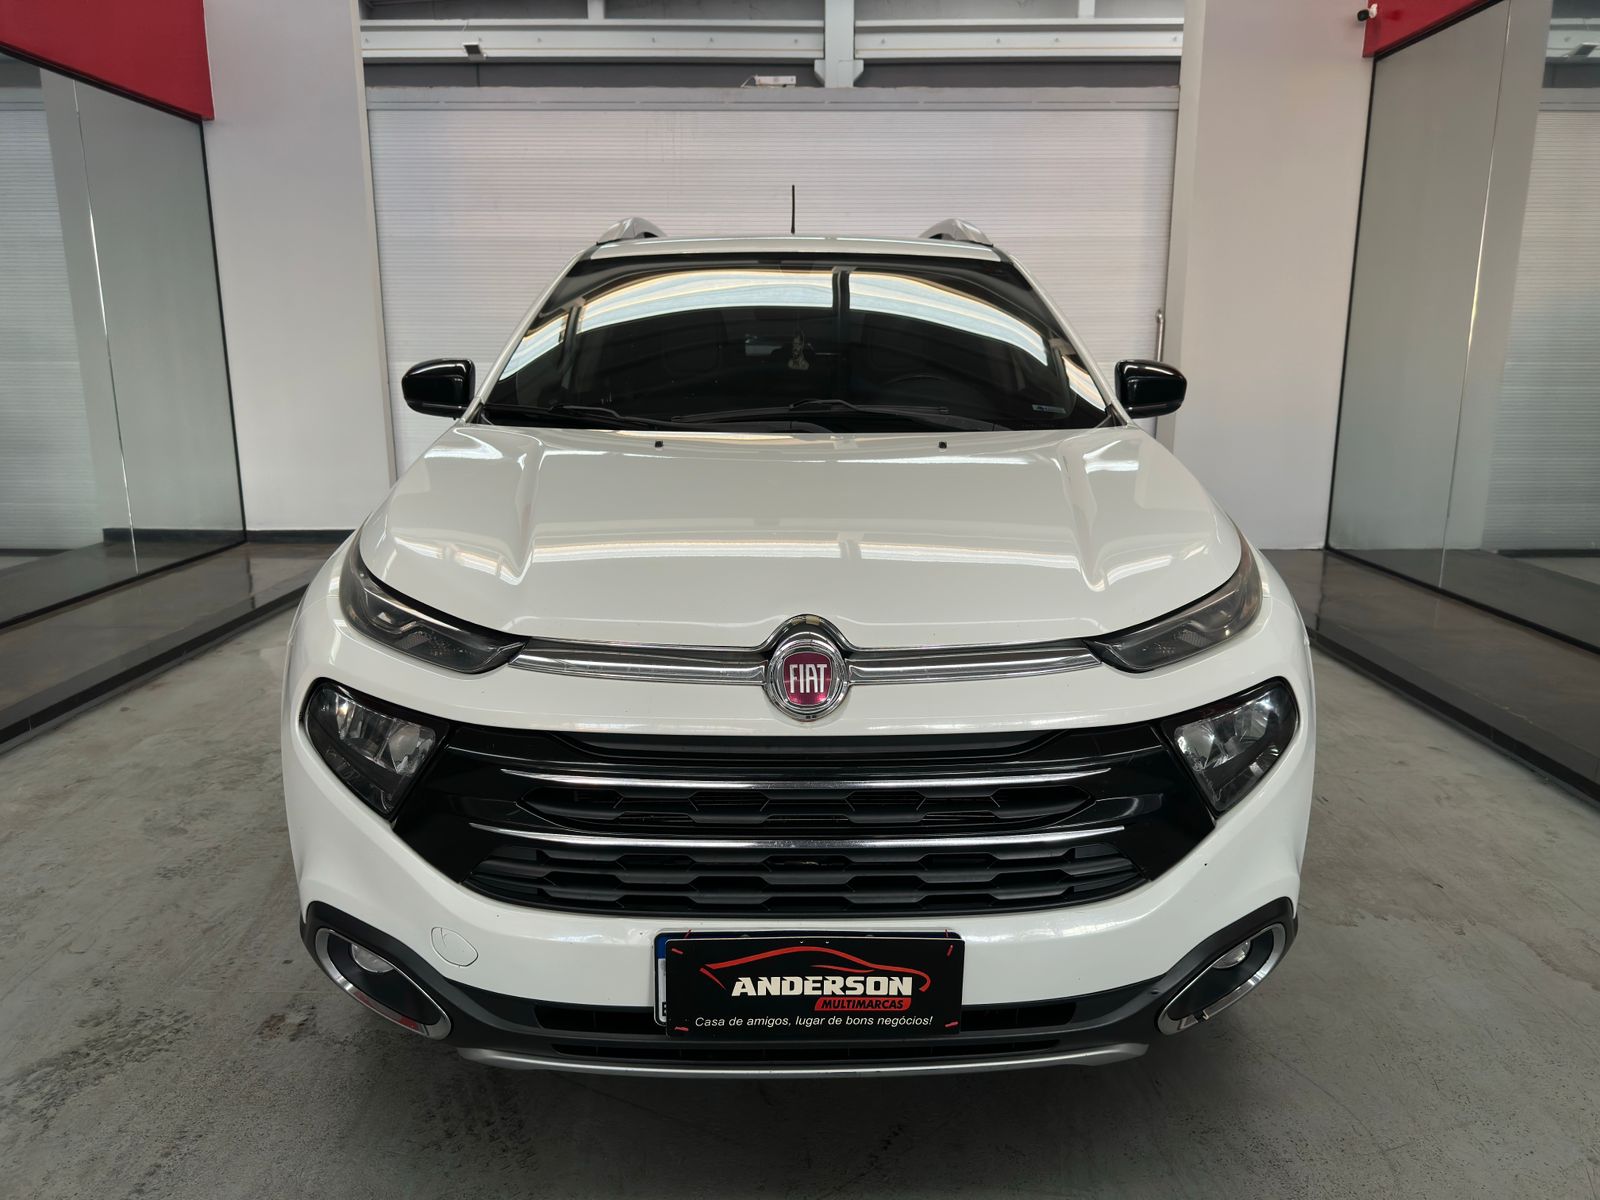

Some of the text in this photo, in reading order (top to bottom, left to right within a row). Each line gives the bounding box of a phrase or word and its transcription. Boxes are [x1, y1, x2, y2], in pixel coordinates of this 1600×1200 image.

[789, 664, 828, 694] FIAT
[731, 975, 913, 997] ANDERSON
[821, 999, 905, 1010] MULTIMARCAS
[695, 1015, 934, 1028] Casa de amigos, lugar de bons negócios!
